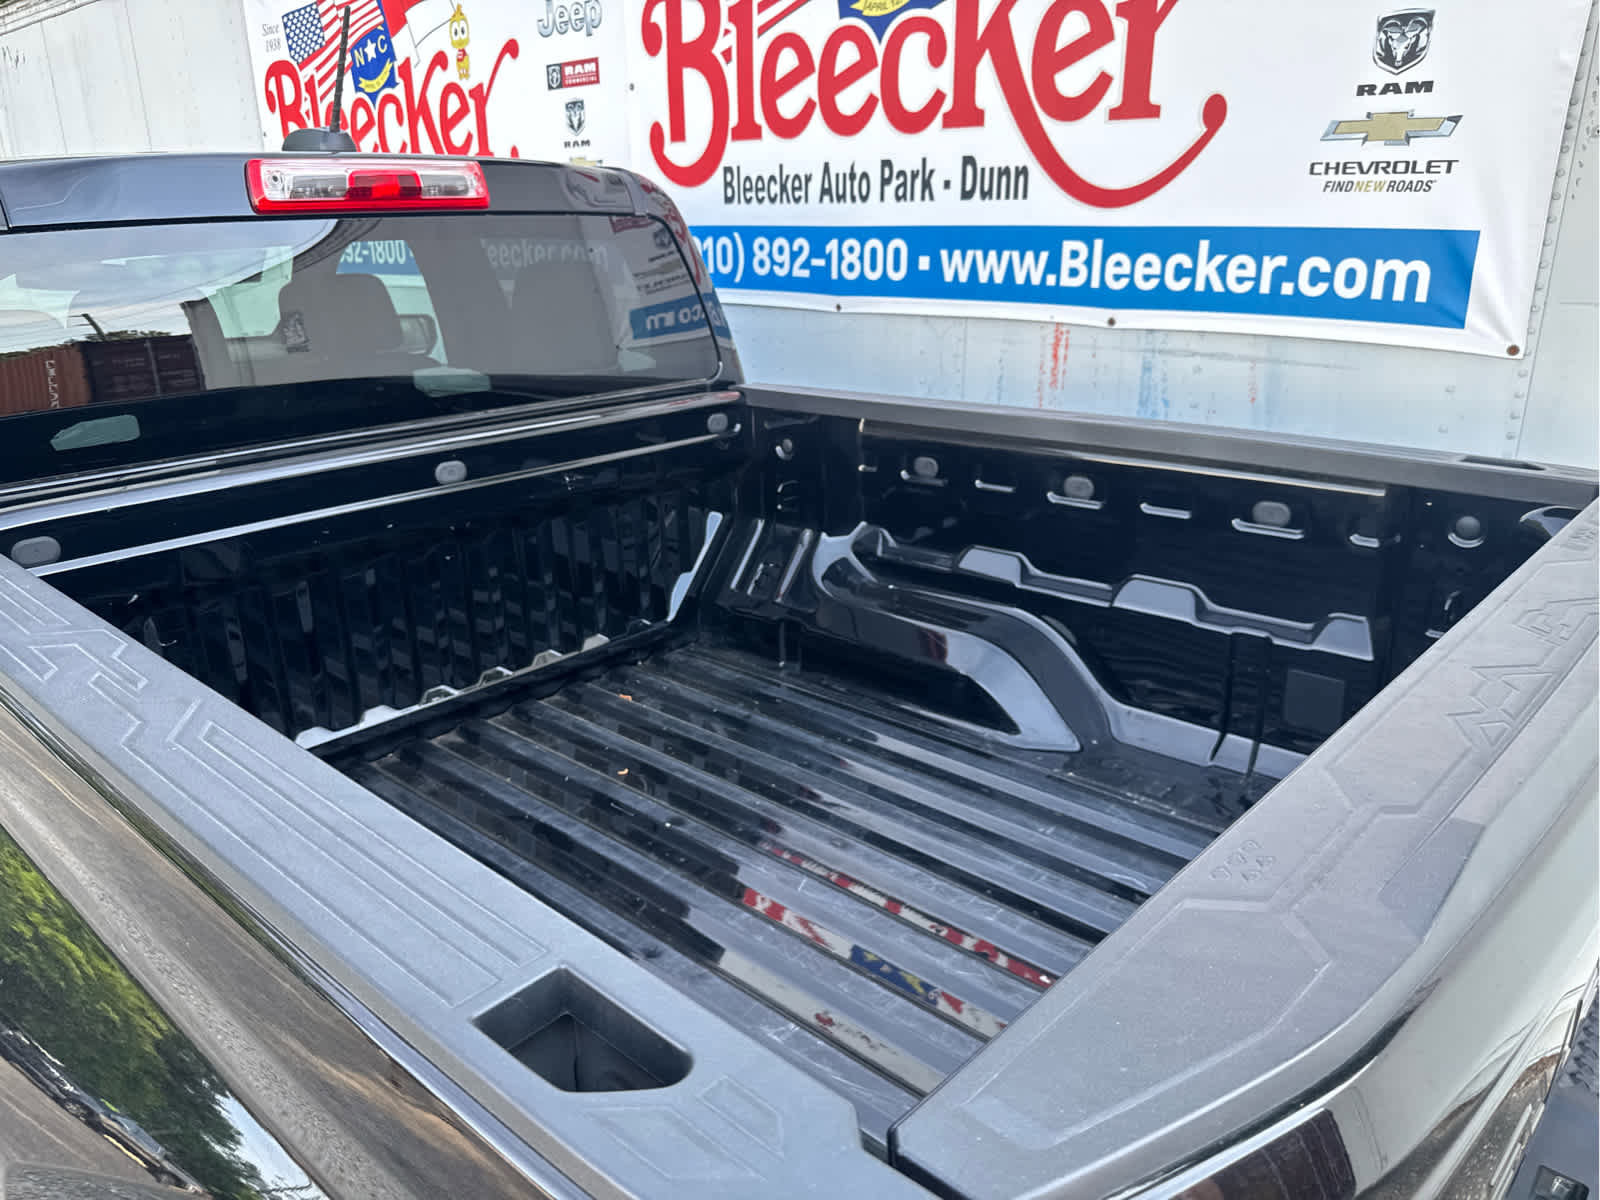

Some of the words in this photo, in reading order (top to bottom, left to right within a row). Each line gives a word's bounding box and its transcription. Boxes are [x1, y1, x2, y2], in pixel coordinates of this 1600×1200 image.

[537, 0, 602, 37] Jeep
[261, 24, 280, 36] Since
[265, 38, 282, 52] 1938
[564, 62, 597, 76] RAM
[1356, 80, 1434, 96] RAM
[641, 0, 1228, 208] Bleecker
[564, 139, 591, 148] RAM
[1308, 160, 1460, 175] CHEVROLET
[723, 165, 813, 205] Bleecker
[819, 161, 870, 204] Auto
[880, 157, 936, 203] Park
[960, 155, 1029, 202] Dunn
[692, 231, 745, 283] 10)
[752, 236, 909, 282] 892-1800
[939, 238, 1431, 304] www.Bleecker.com
